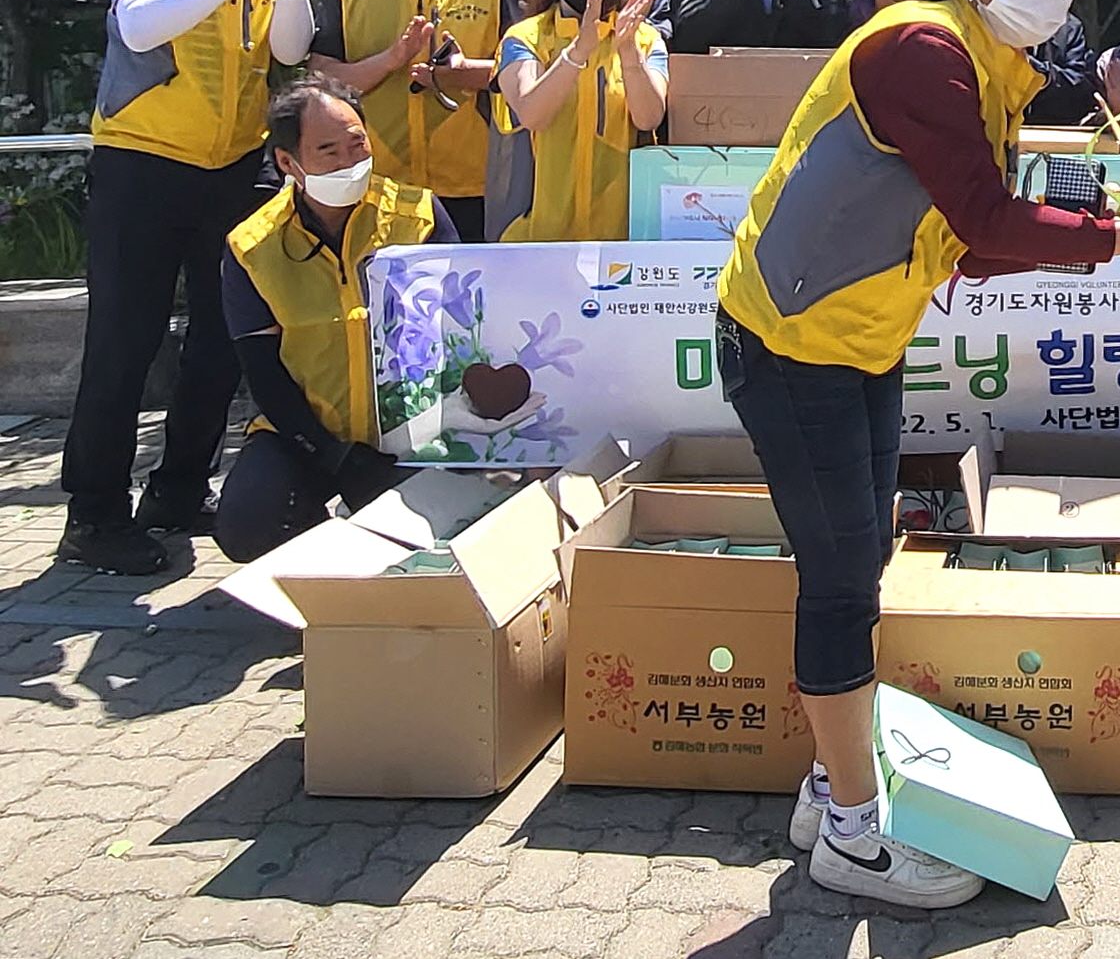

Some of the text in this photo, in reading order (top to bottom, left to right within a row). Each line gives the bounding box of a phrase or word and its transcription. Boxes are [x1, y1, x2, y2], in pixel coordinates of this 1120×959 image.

[637, 267, 681, 281] 강원도
[607, 302, 649, 315] 사단법인
[946, 413, 970, 433] 5.
[643, 699, 766, 731] 서부농원
